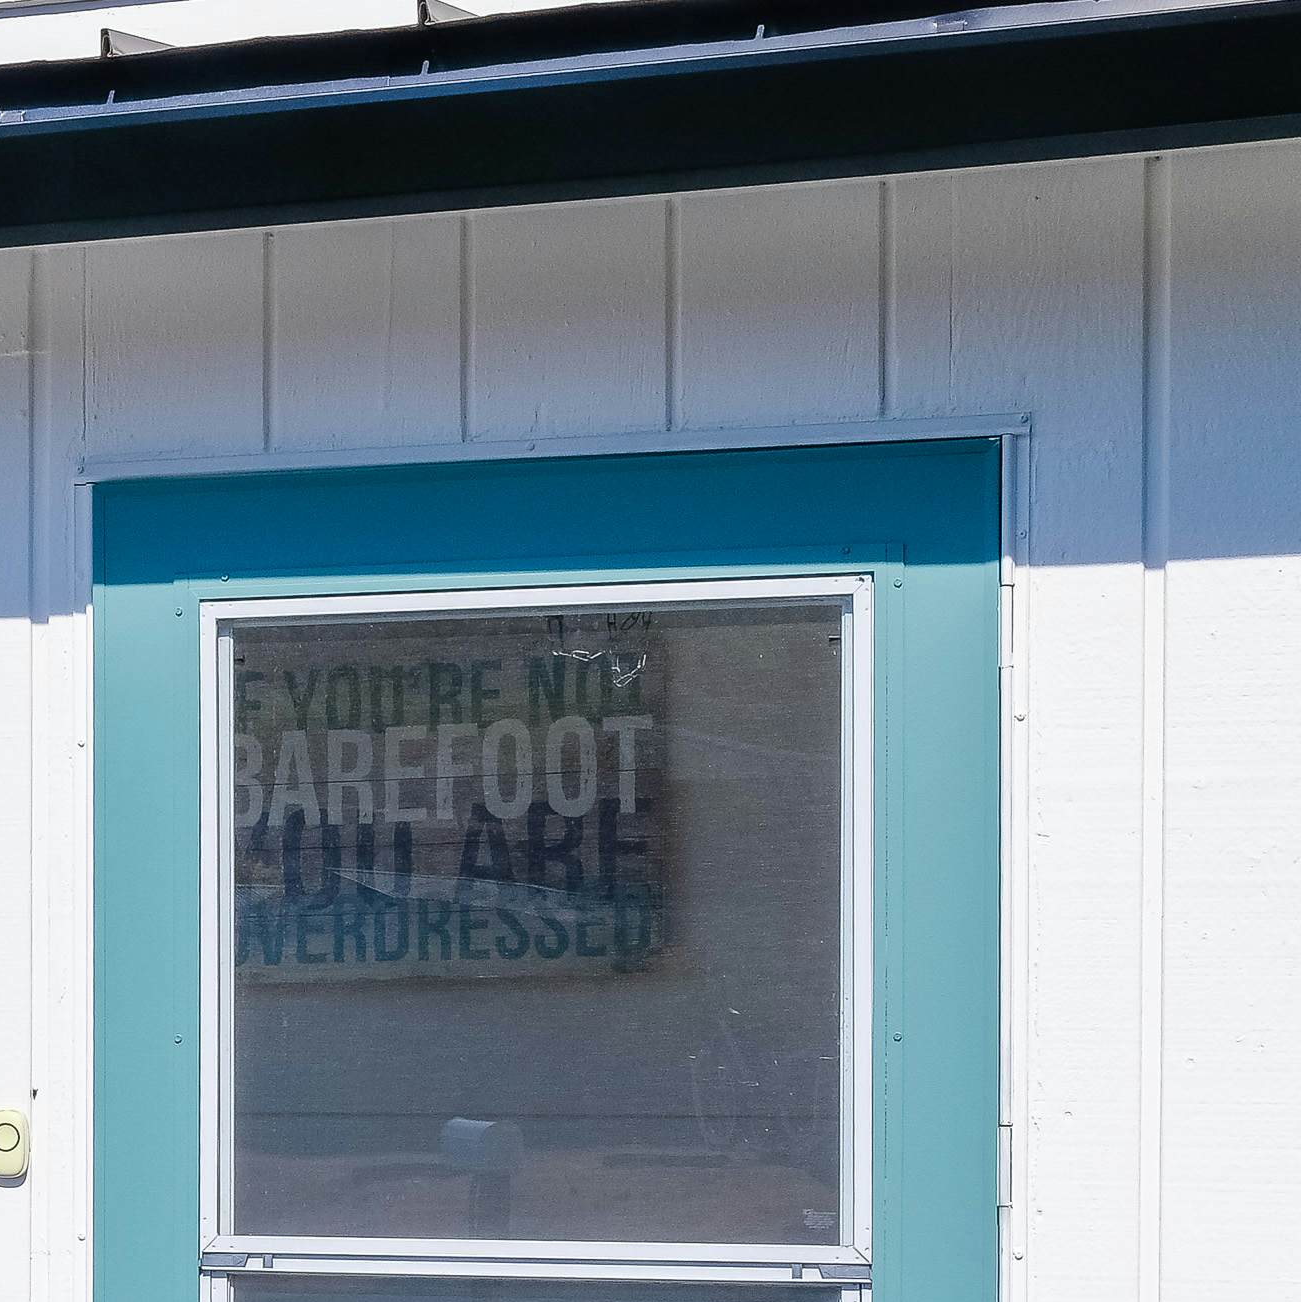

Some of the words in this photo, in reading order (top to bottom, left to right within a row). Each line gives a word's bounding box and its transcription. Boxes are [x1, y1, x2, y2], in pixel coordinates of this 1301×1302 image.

[282, 658, 502, 733] YOU'RE
[528, 650, 645, 724] NOT
[234, 714, 654, 828] BAREFOOT
[454, 798, 649, 897] ARE
